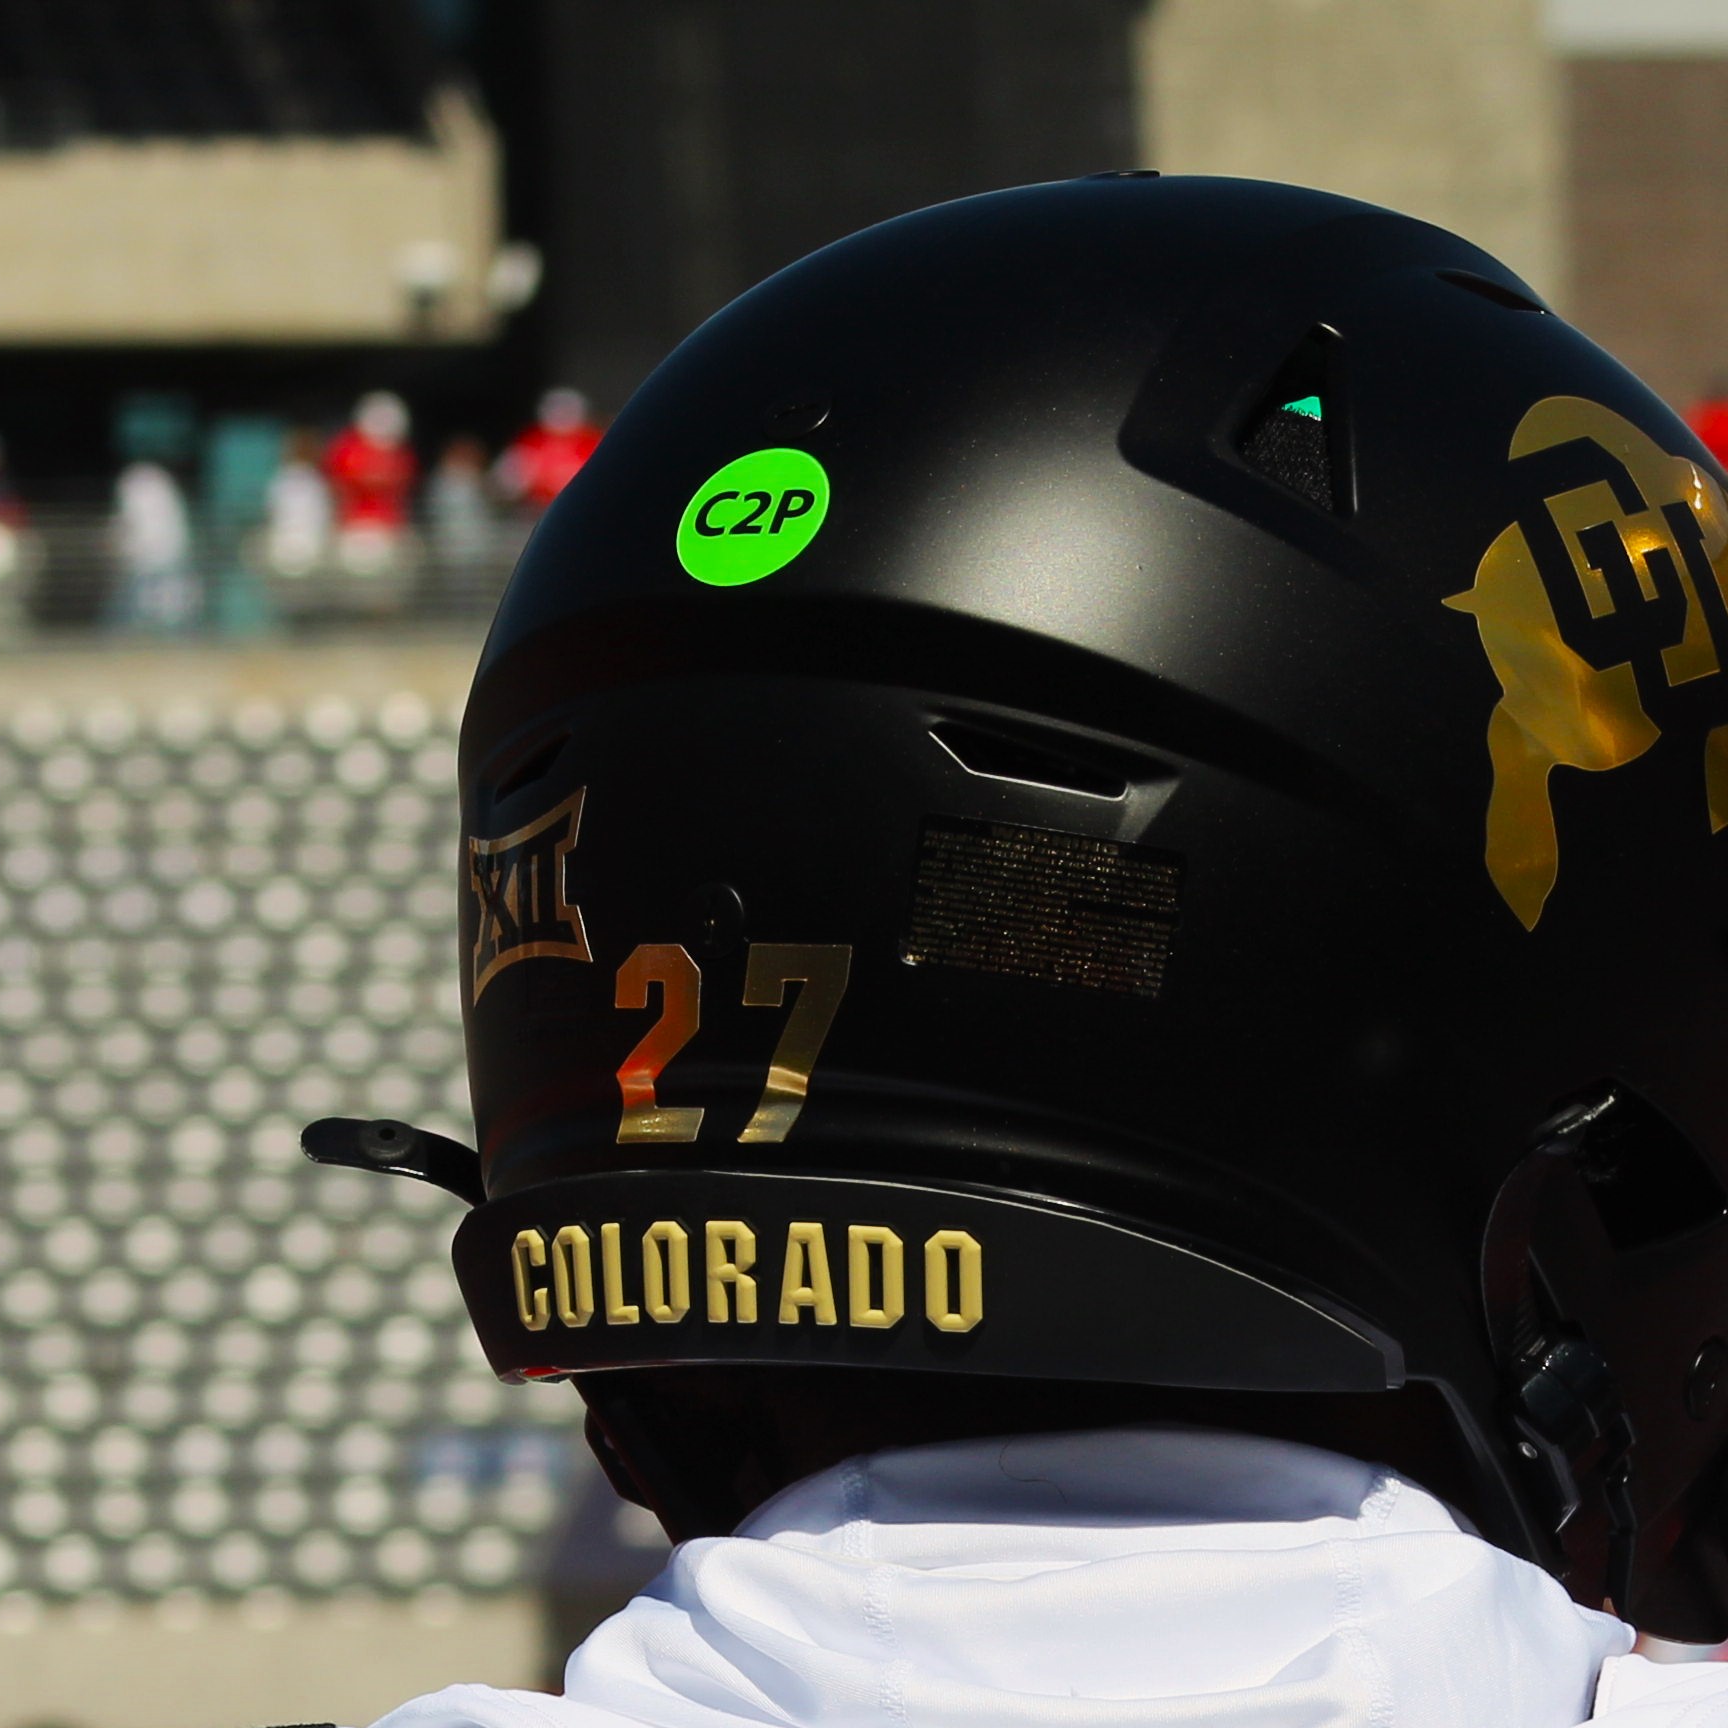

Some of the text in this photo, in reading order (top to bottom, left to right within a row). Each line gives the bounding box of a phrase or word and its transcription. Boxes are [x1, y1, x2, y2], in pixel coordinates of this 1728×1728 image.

[694, 488, 816, 538] C2P
[614, 943, 853, 1144] 27
[509, 1219, 985, 1333] COLORADO
